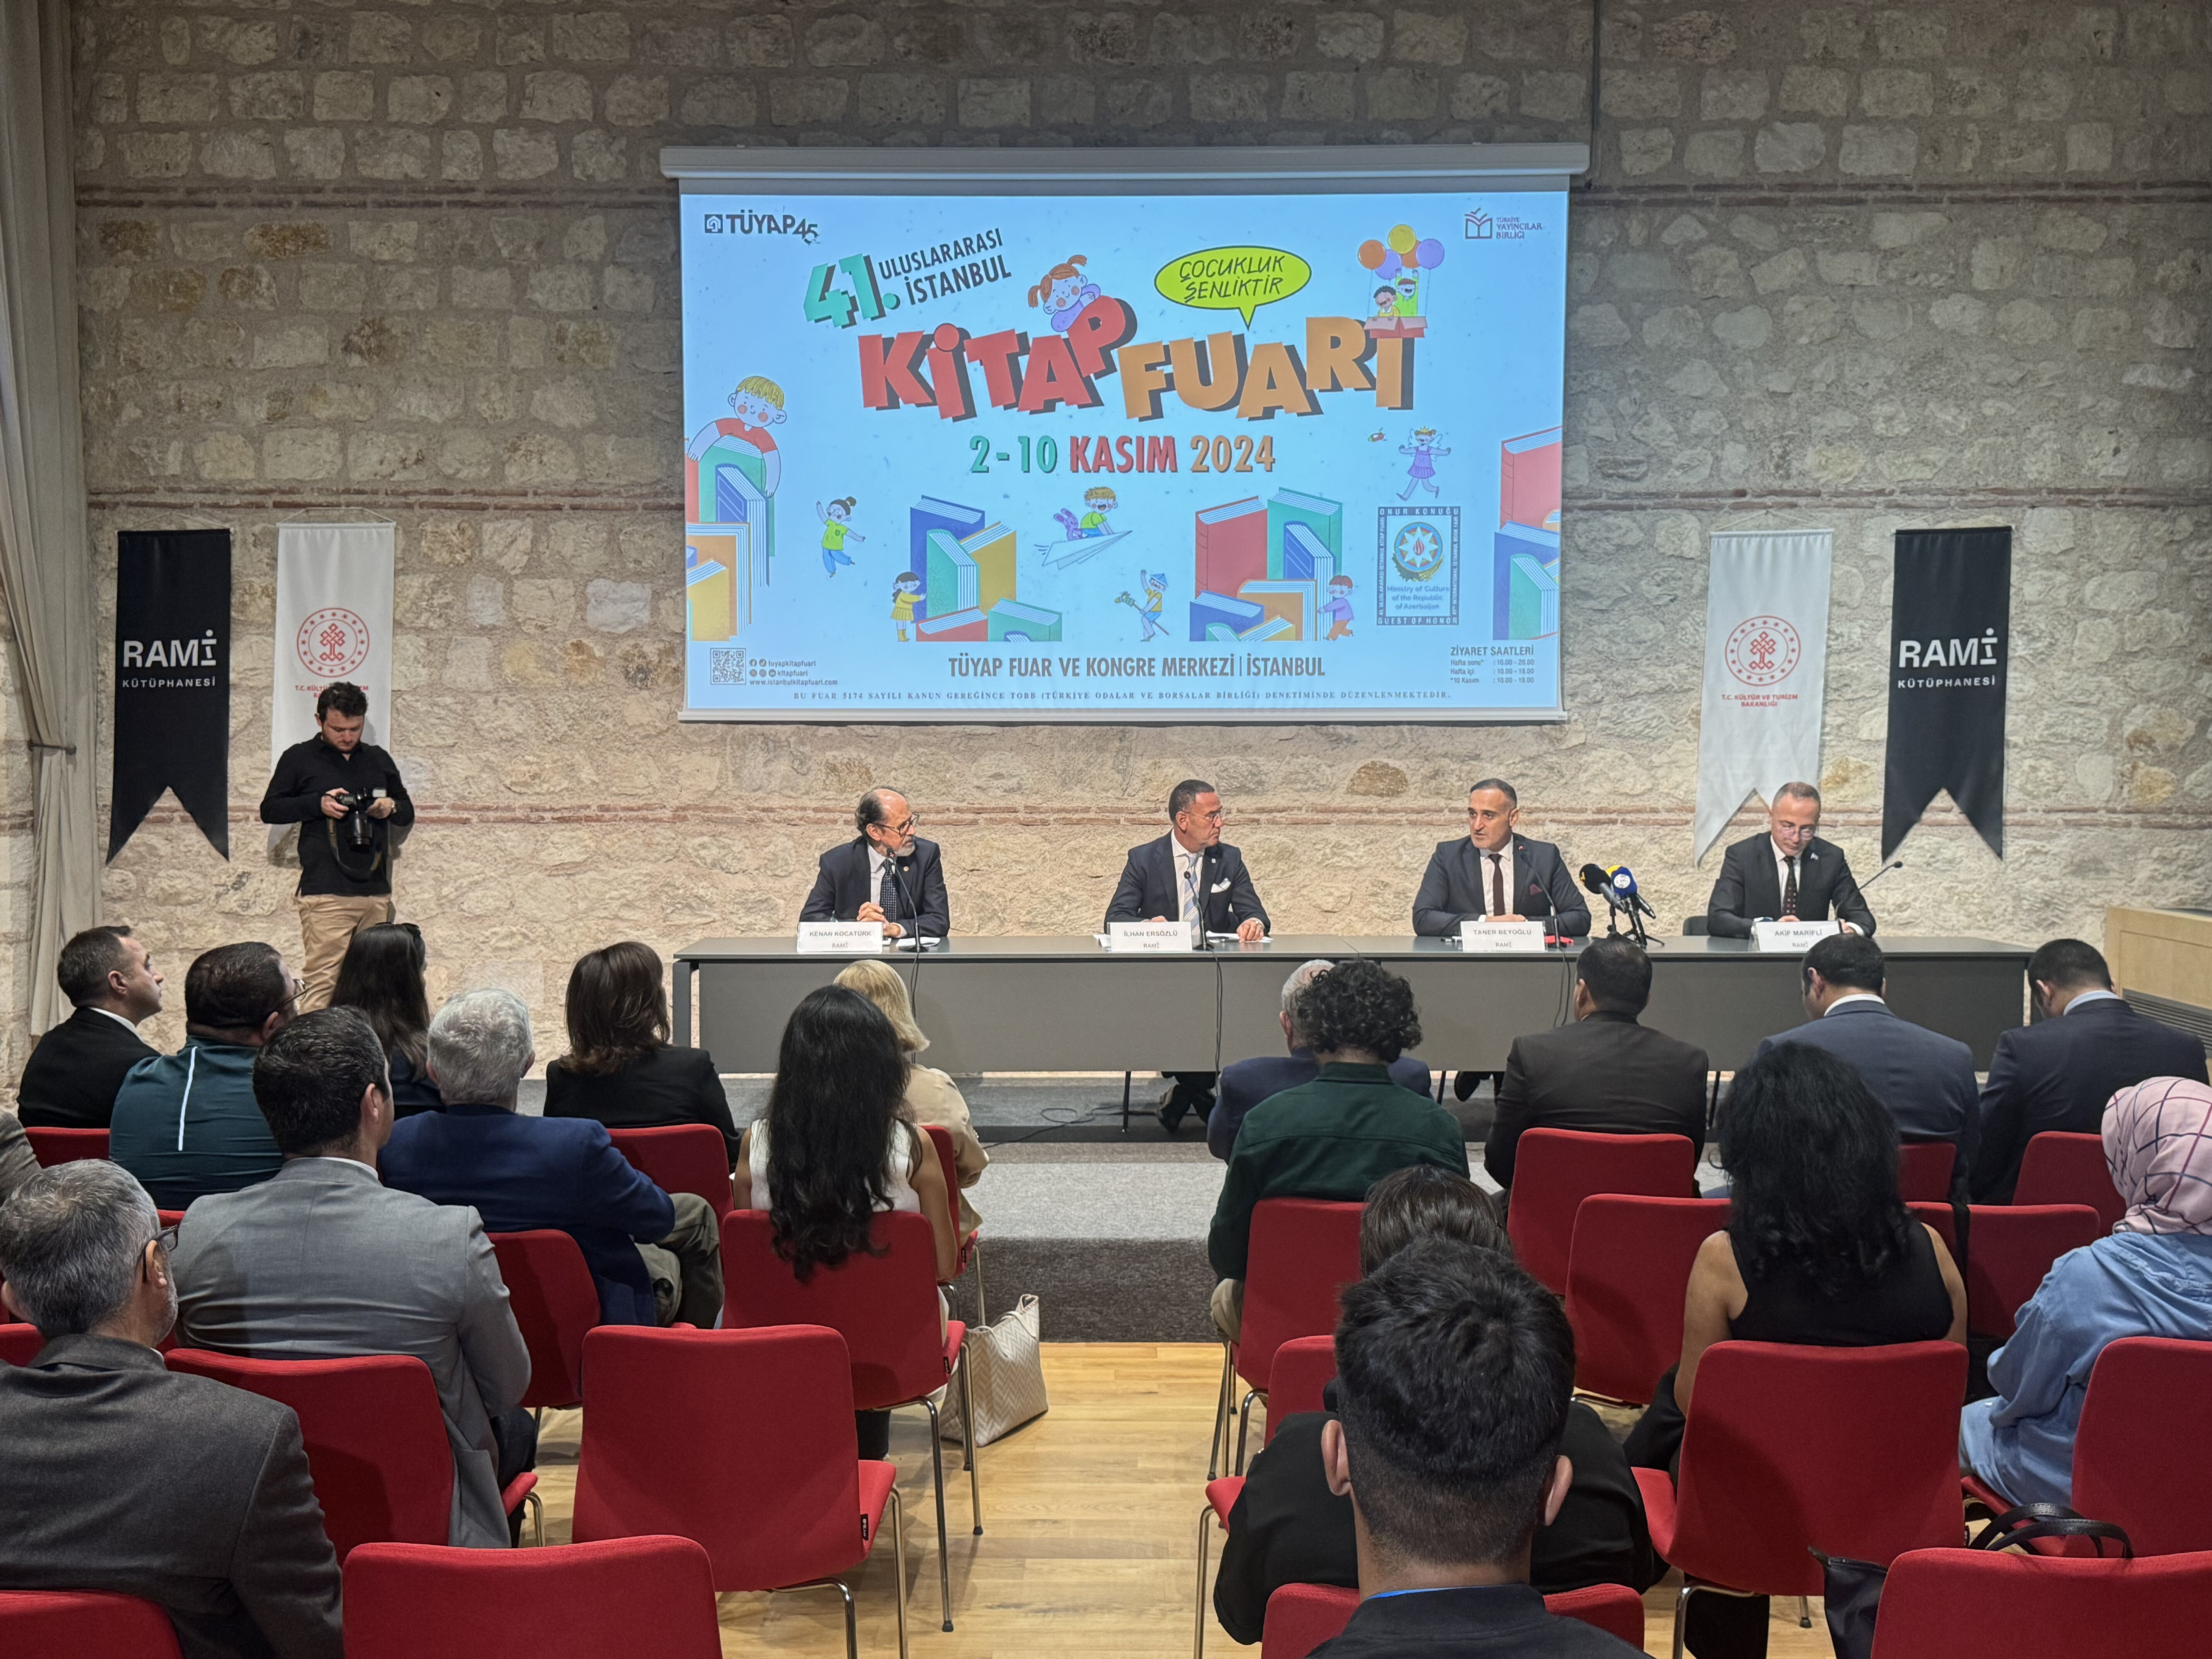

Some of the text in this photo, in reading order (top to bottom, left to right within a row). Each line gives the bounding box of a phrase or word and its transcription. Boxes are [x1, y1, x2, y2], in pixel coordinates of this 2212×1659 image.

[726, 209, 795, 234] TÜYAP
[1496, 231, 1525, 239] BİRLİĞİ
[879, 228, 1003, 280] ULUSLARARASI
[905, 254, 1012, 305] İSTANBUL
[1180, 256, 1285, 282] ÇOCUKLUK
[804, 253, 900, 329] 41.
[1184, 275, 1283, 303] ŞENLİKTİR
[858, 295, 1414, 422] KİTAP FUARI
[1070, 435, 1178, 473] KASIM
[1190, 435, 1275, 473] 2024
[123, 629, 217, 667] RAMİ
[1451, 645, 1534, 656] ZİYARET SAATLERİ
[1899, 628, 1998, 668] RAMİ
[949, 652, 1325, 677] TÜYAP FUAR VE KONGRE MERKEZİ İSTANBUL
[122, 676, 215, 688] KÜTÜPHANESİ
[947, 691, 1005, 699] GEREĞİNCE
[1898, 675, 1995, 688] KÜTÜPHANESİ
